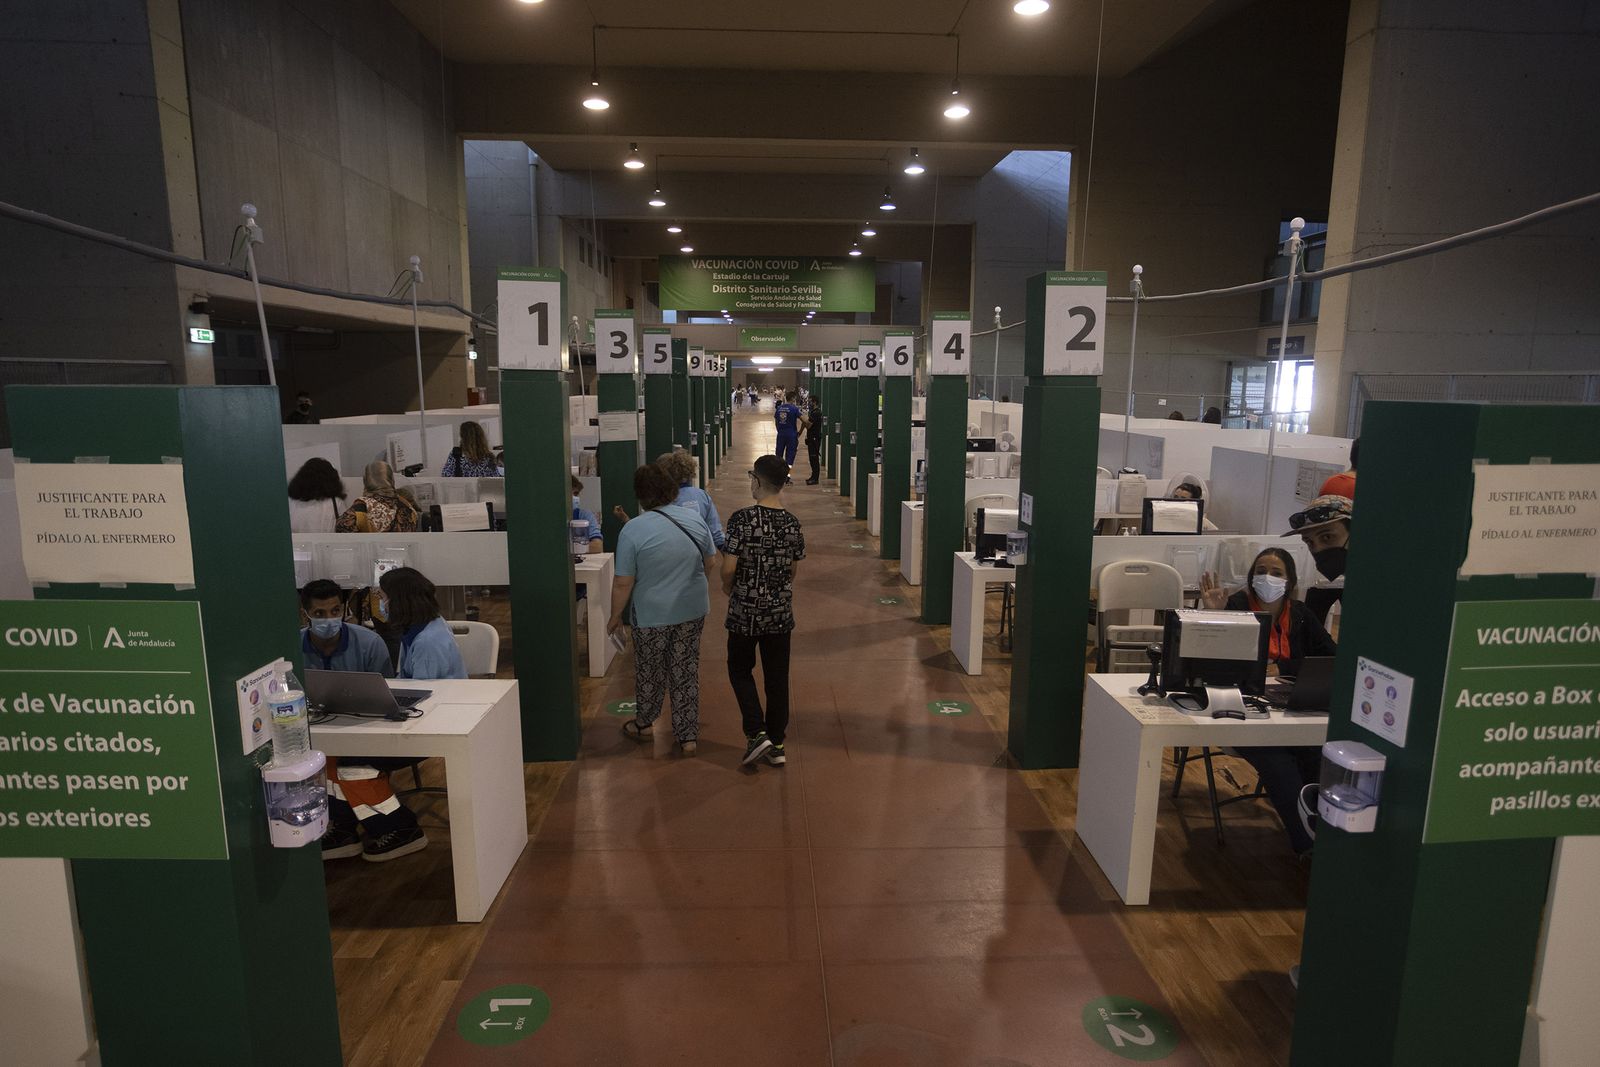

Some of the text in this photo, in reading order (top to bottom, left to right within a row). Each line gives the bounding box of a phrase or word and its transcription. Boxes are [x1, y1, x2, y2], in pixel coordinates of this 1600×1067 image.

[691, 258, 799, 270] VACUNACIÓN COVID
[712, 272, 789, 282] Estadio de la Cartuja
[712, 284, 822, 294] Distrito Sanitario Sevilla
[528, 302, 549, 346] 1
[1065, 305, 1097, 351] 2
[609, 330, 629, 359] 3
[943, 333, 965, 360] 4
[653, 343, 668, 364] 5
[865, 352, 877, 368] 8
[893, 345, 909, 366] 6
[690, 355, 701, 370] 9
[713, 361, 719, 371] 3
[719, 363, 726, 372] 5
[830, 360, 842, 372] 12
[843, 357, 859, 371] 10
[37, 492, 167, 504] JUSTIFICANTE PARA
[1487, 490, 1597, 502] JUSTIFICANTE PARA
[64, 507, 144, 519] EL TRABAJO
[1509, 504, 1576, 516] EL TRABAJO
[36, 531, 176, 544] PÍDALO AL ENFERMERO
[1481, 527, 1597, 540] PÍDALO AL ENFERMERO
[5, 627, 78, 647] COVID
[127, 629, 149, 638] Junta
[127, 639, 176, 648] de Andalucía
[13, 691, 45, 713] de
[48, 693, 196, 715] Vacunación
[1455, 685, 1593, 708] Acceso a Box
[1484, 721, 1528, 742] solo
[63, 731, 161, 755] citados,
[65, 774, 140, 795] pasen
[146, 775, 189, 796] por
[1489, 790, 1571, 816] pasillos
[25, 807, 152, 828] exteriores
[489, 998, 533, 1013] 1
[1106, 1023, 1156, 1047] 2
